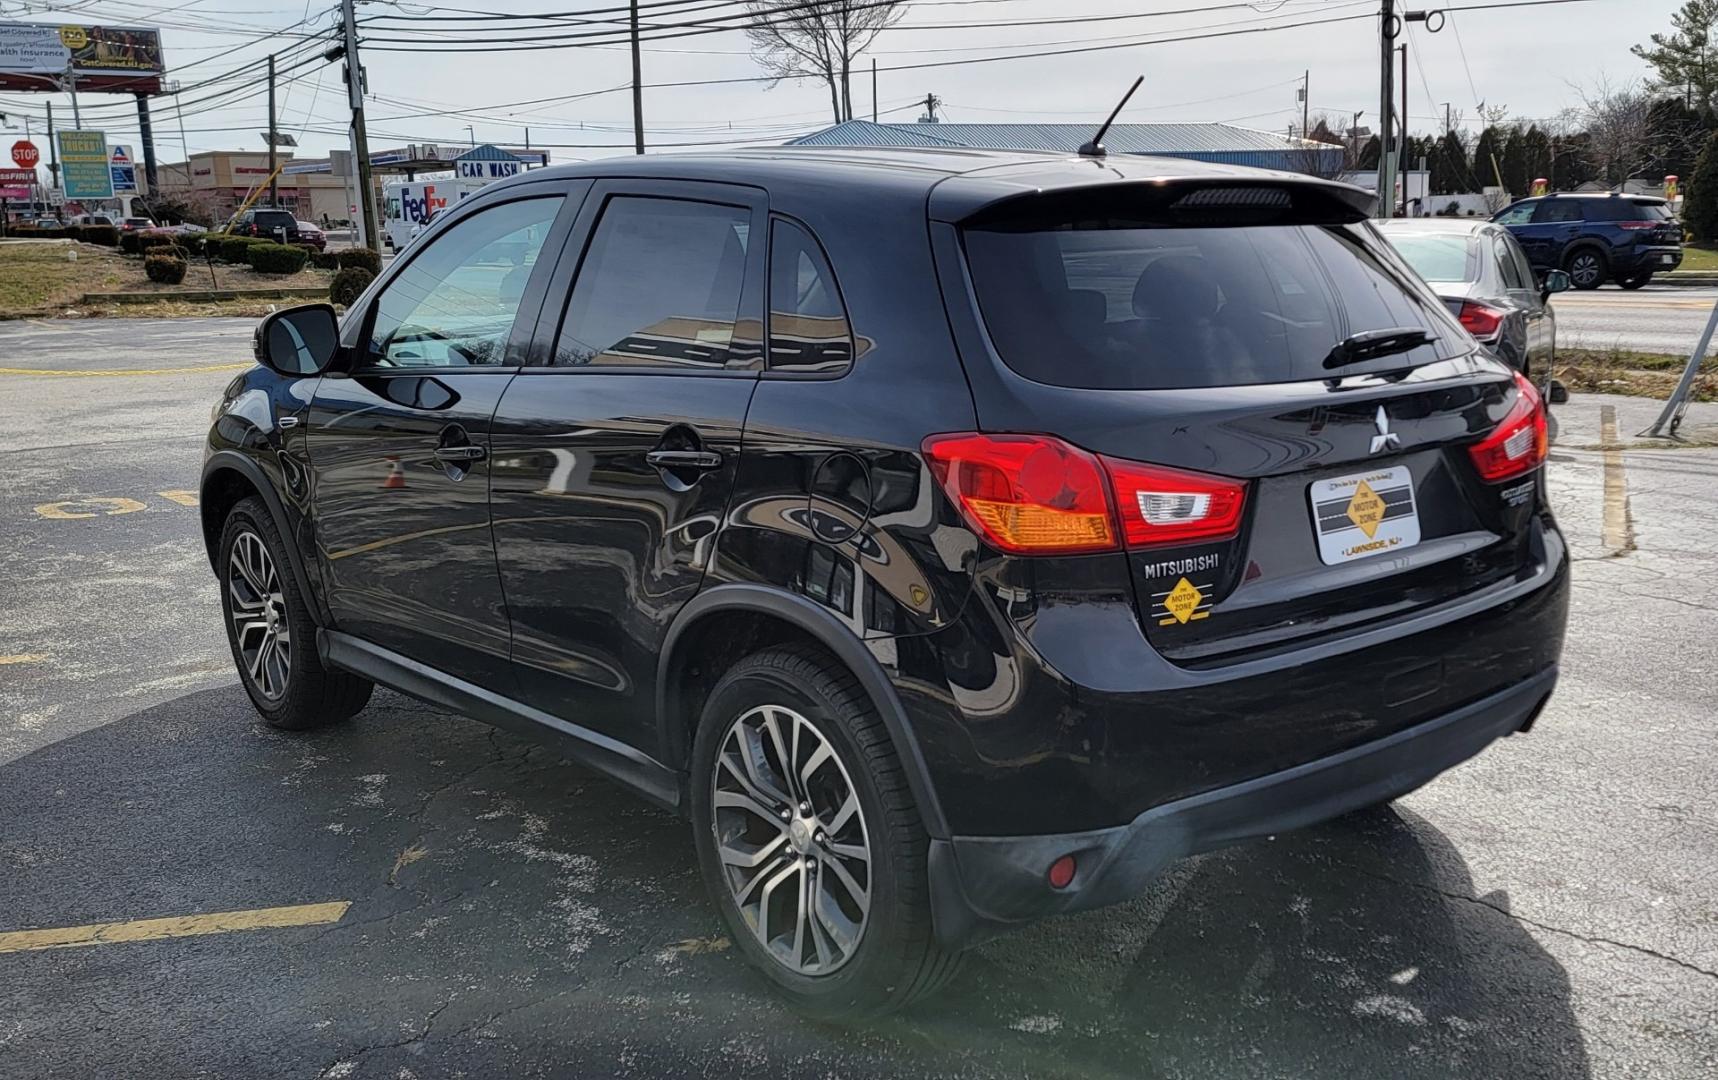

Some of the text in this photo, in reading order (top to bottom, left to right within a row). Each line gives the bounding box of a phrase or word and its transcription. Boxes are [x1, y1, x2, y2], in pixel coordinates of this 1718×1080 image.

[13, 149, 37, 160] STOP
[462, 162, 518, 178] CAR WASH
[1353, 499, 1379, 513] MOTOR
[1359, 511, 1377, 525] ZONE
[1144, 553, 1219, 579] MITSUBISHI
[1171, 592, 1196, 603] MOTOR
[1174, 602, 1193, 612] ZONE
